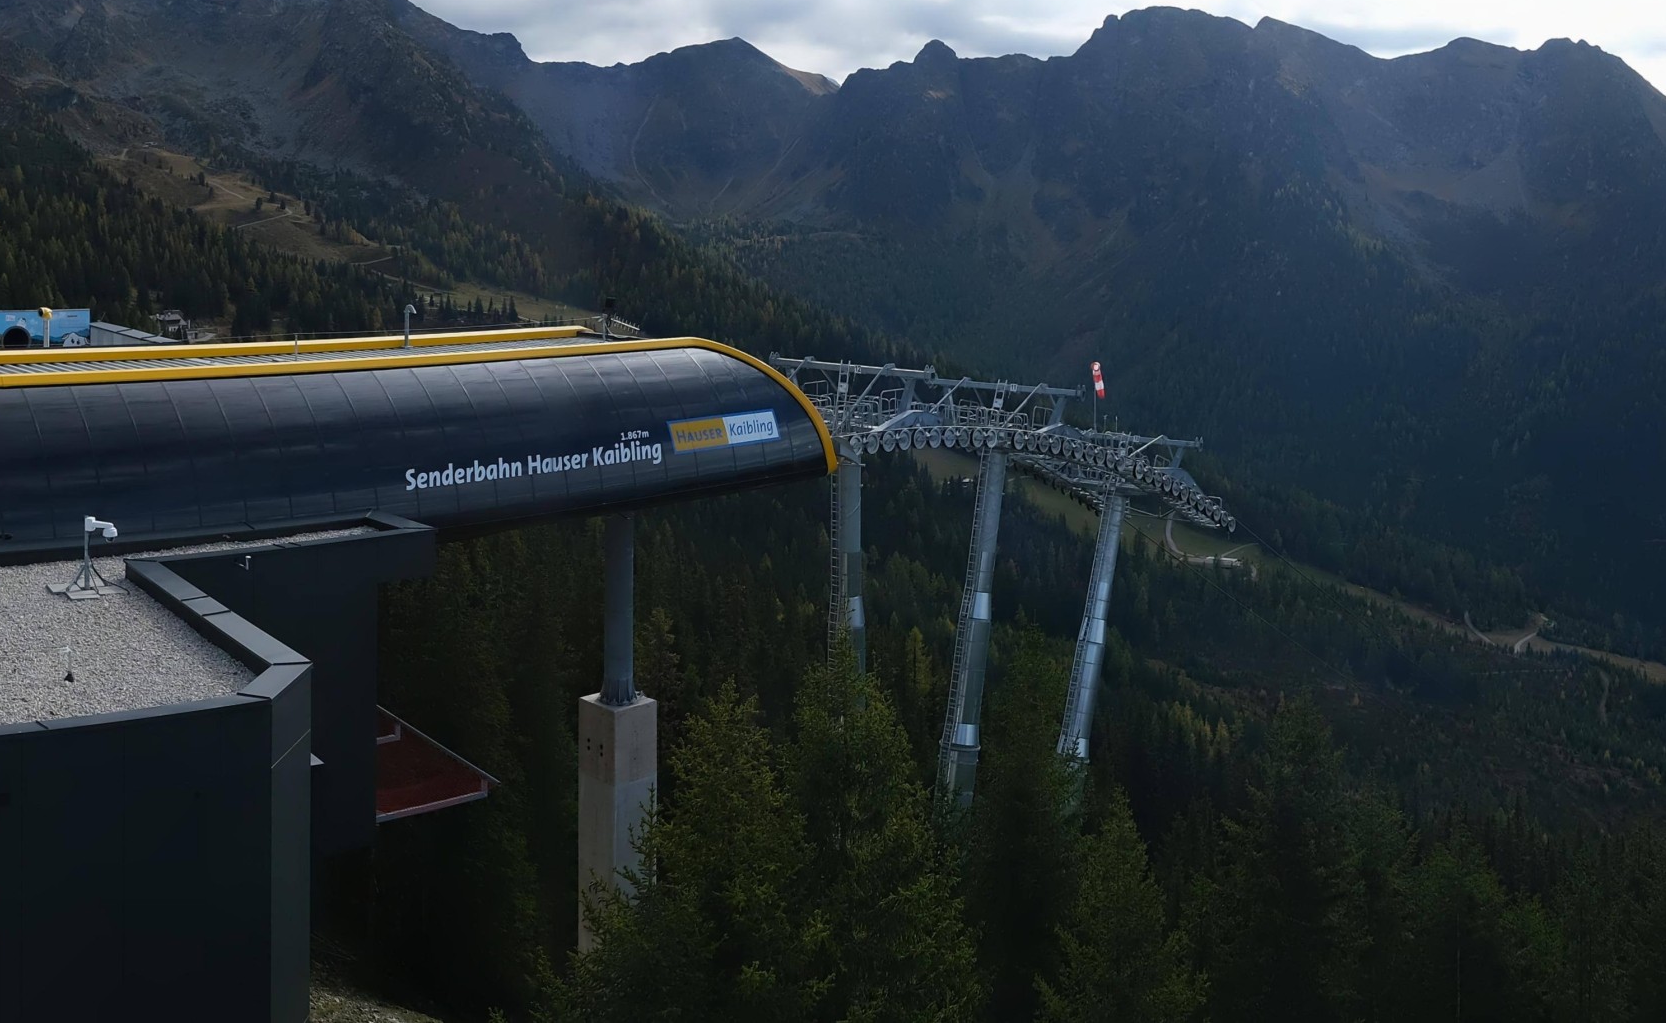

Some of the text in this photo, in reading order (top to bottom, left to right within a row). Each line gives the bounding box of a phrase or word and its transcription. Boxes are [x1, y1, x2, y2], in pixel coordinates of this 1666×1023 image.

[620, 430, 650, 441] 1.867m
[676, 419, 774, 444] HAUSER Kaibling
[405, 440, 662, 491] Senderbahn Hauser Kaibling
